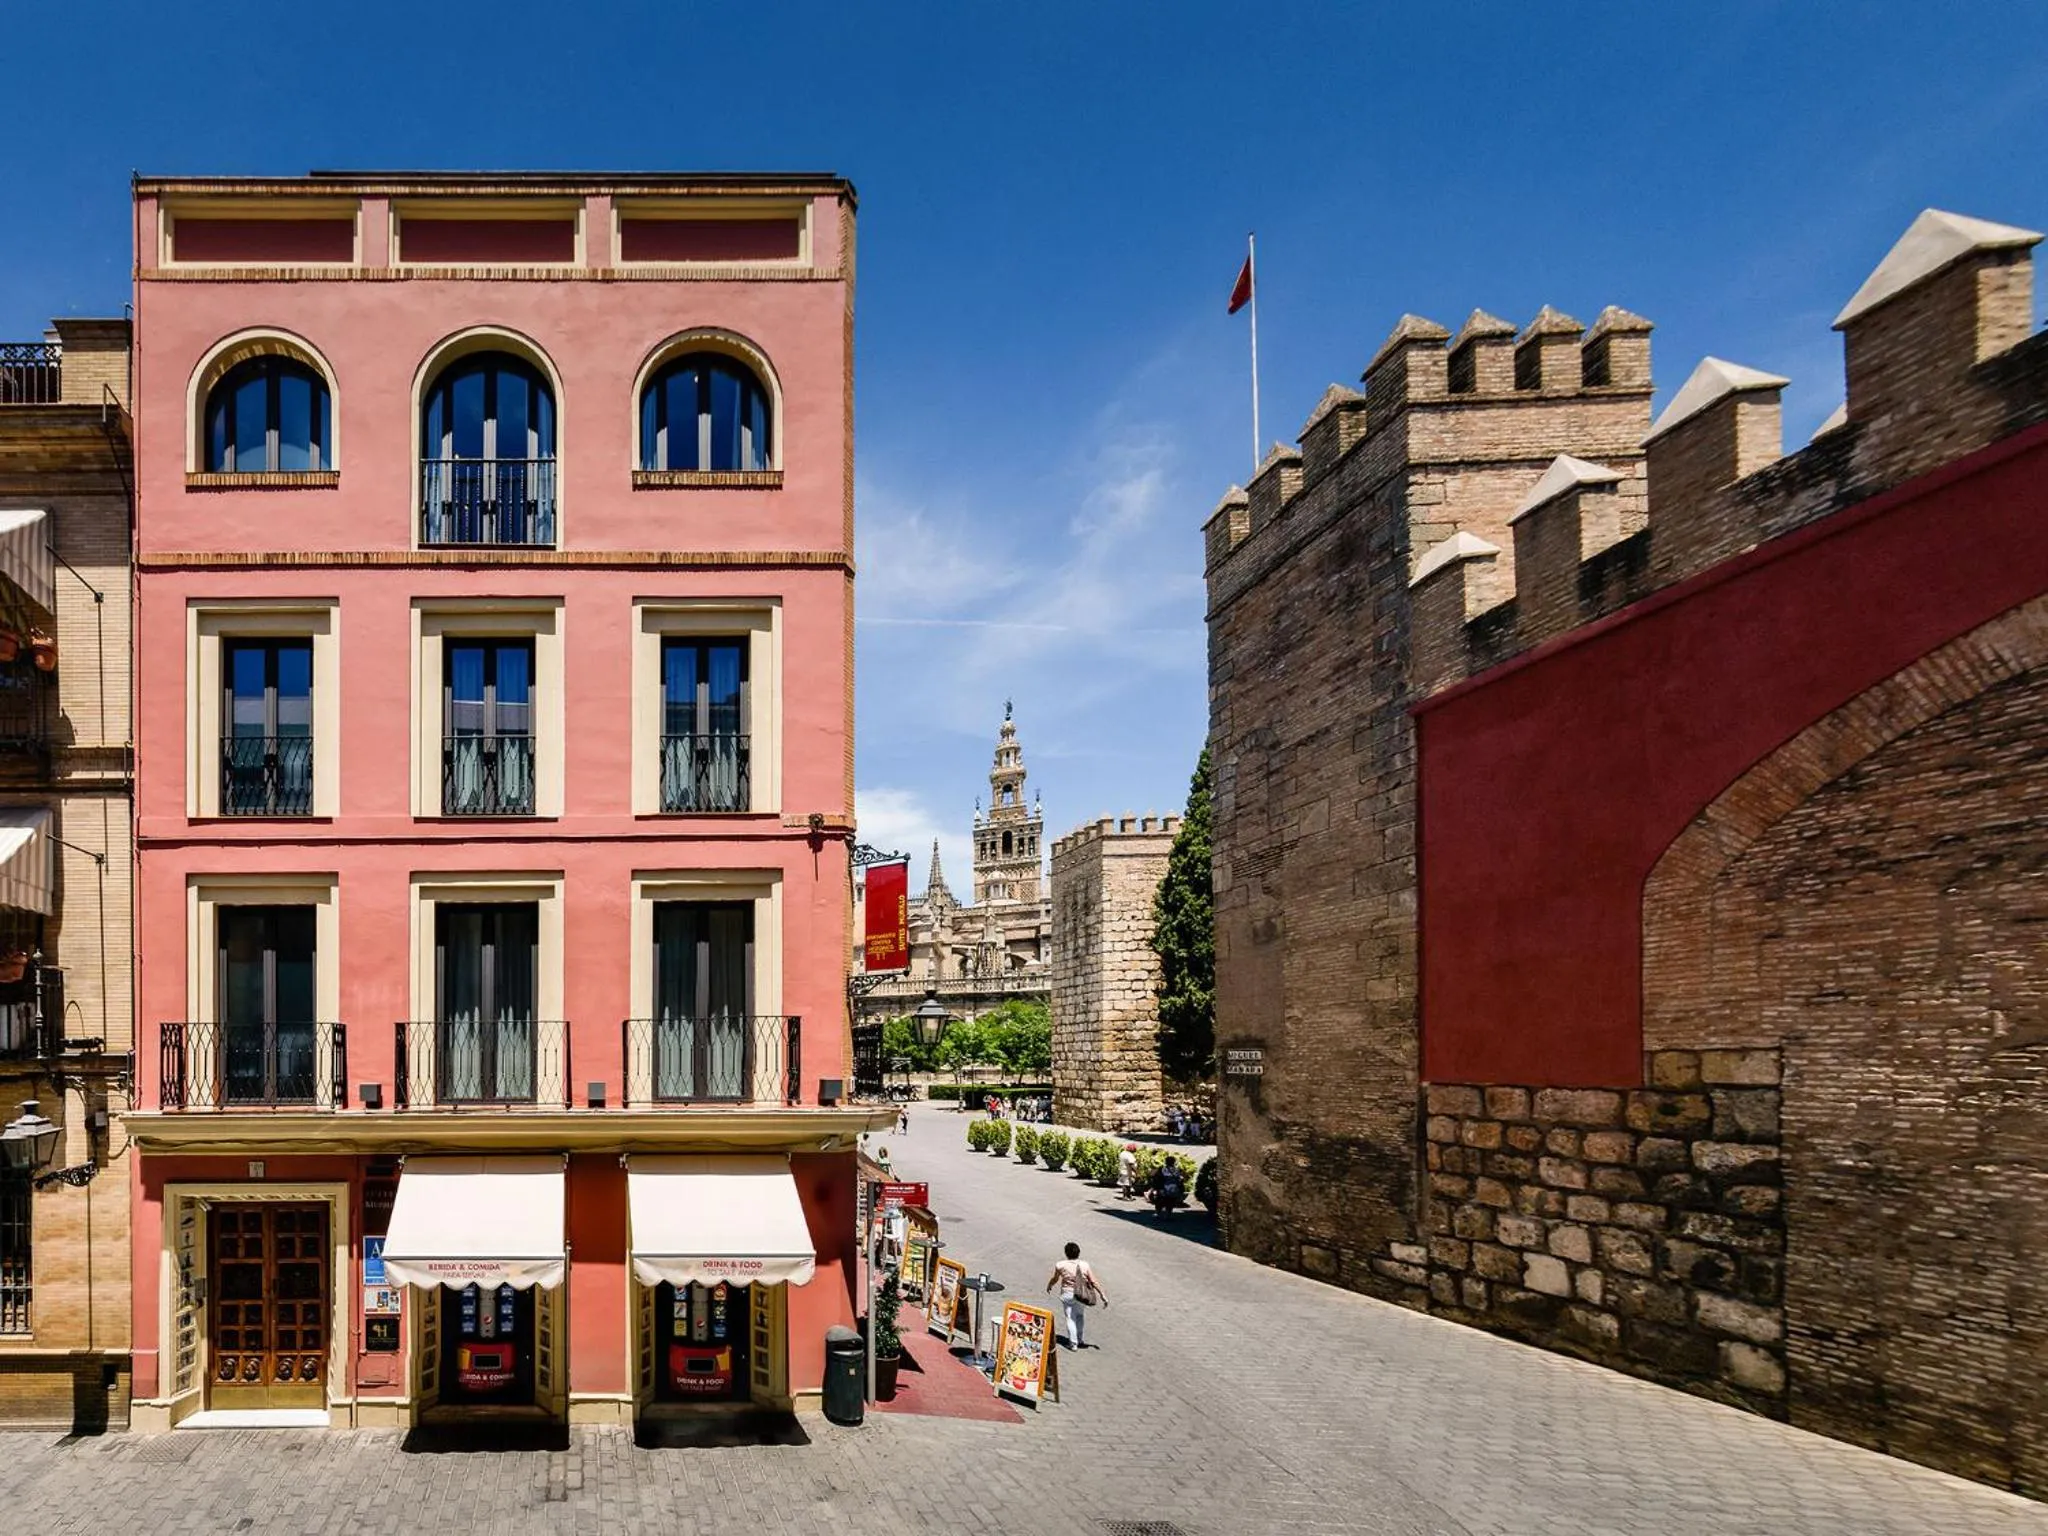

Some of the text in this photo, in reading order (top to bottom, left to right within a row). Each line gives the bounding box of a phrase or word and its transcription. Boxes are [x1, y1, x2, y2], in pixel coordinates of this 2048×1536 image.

[898, 894, 906, 925] MURILLO
[428, 1263, 457, 1271] BEBIDA
[467, 1263, 501, 1271] COMIDA
[739, 1261, 763, 1269] FOOD
